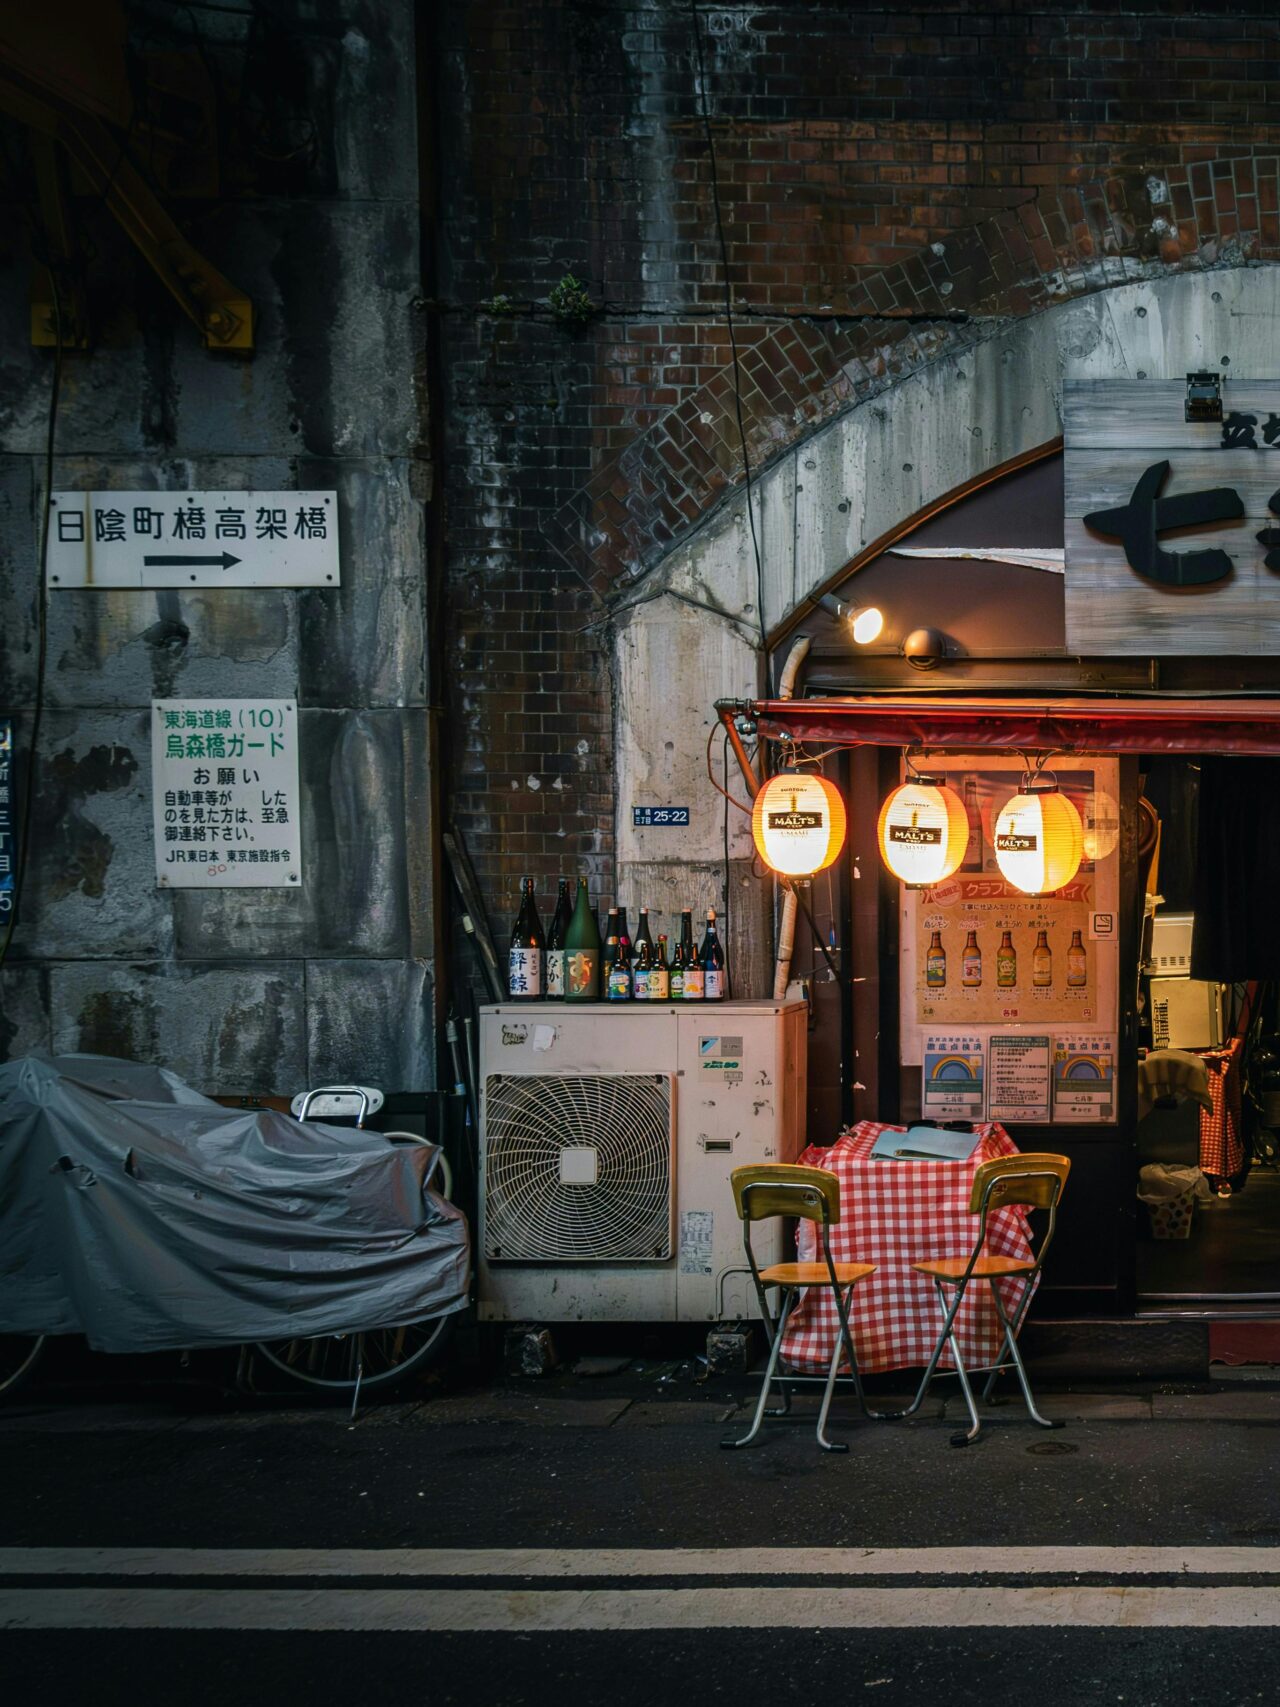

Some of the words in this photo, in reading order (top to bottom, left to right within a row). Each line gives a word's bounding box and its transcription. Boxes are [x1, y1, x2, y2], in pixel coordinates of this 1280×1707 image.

[57, 507, 328, 543] 日陰町橋高架橋
[193, 767, 260, 785] お願い
[165, 790, 232, 806] 自動車等が
[262, 790, 287, 806] した
[654, 811, 687, 822] 25-22
[775, 816, 816, 826] MALT'S
[165, 826, 255, 842] 御連絡下さい。
[895, 831, 935, 841] MALT'S
[166, 850, 219, 863] JR東日本
[227, 849, 291, 863] 東京施設指令
